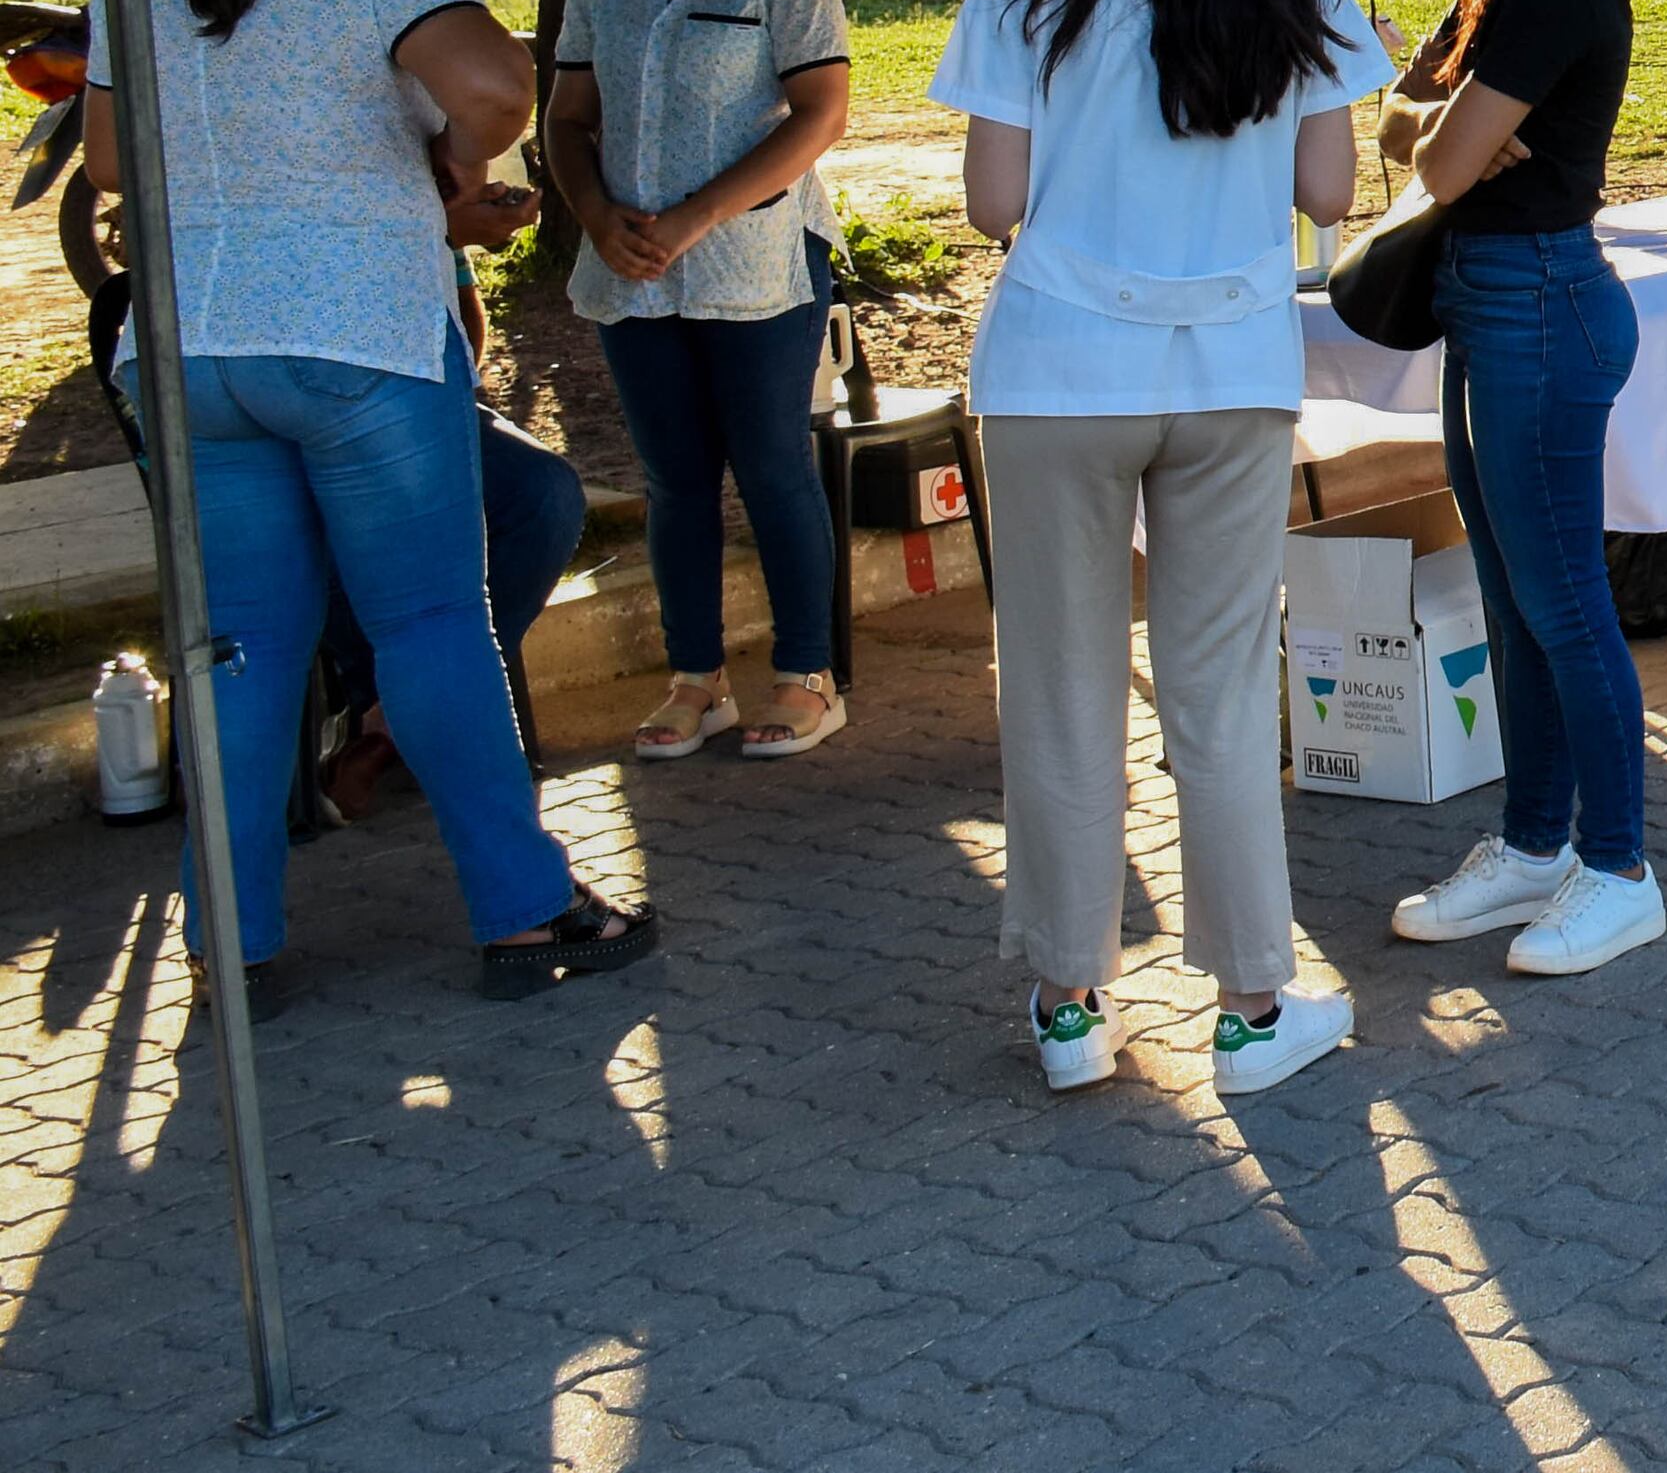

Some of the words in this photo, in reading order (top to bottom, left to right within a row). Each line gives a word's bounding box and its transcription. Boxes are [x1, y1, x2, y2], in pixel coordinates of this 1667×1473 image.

[1342, 680, 1405, 701] UNCAUS
[1344, 700, 1394, 712] UNIVERSIDAD
[1344, 711, 1383, 722] NACIONAL
[1385, 714, 1399, 725] DEL
[1345, 722, 1371, 732] CHACO
[1307, 753, 1358, 778] FRAGIL
